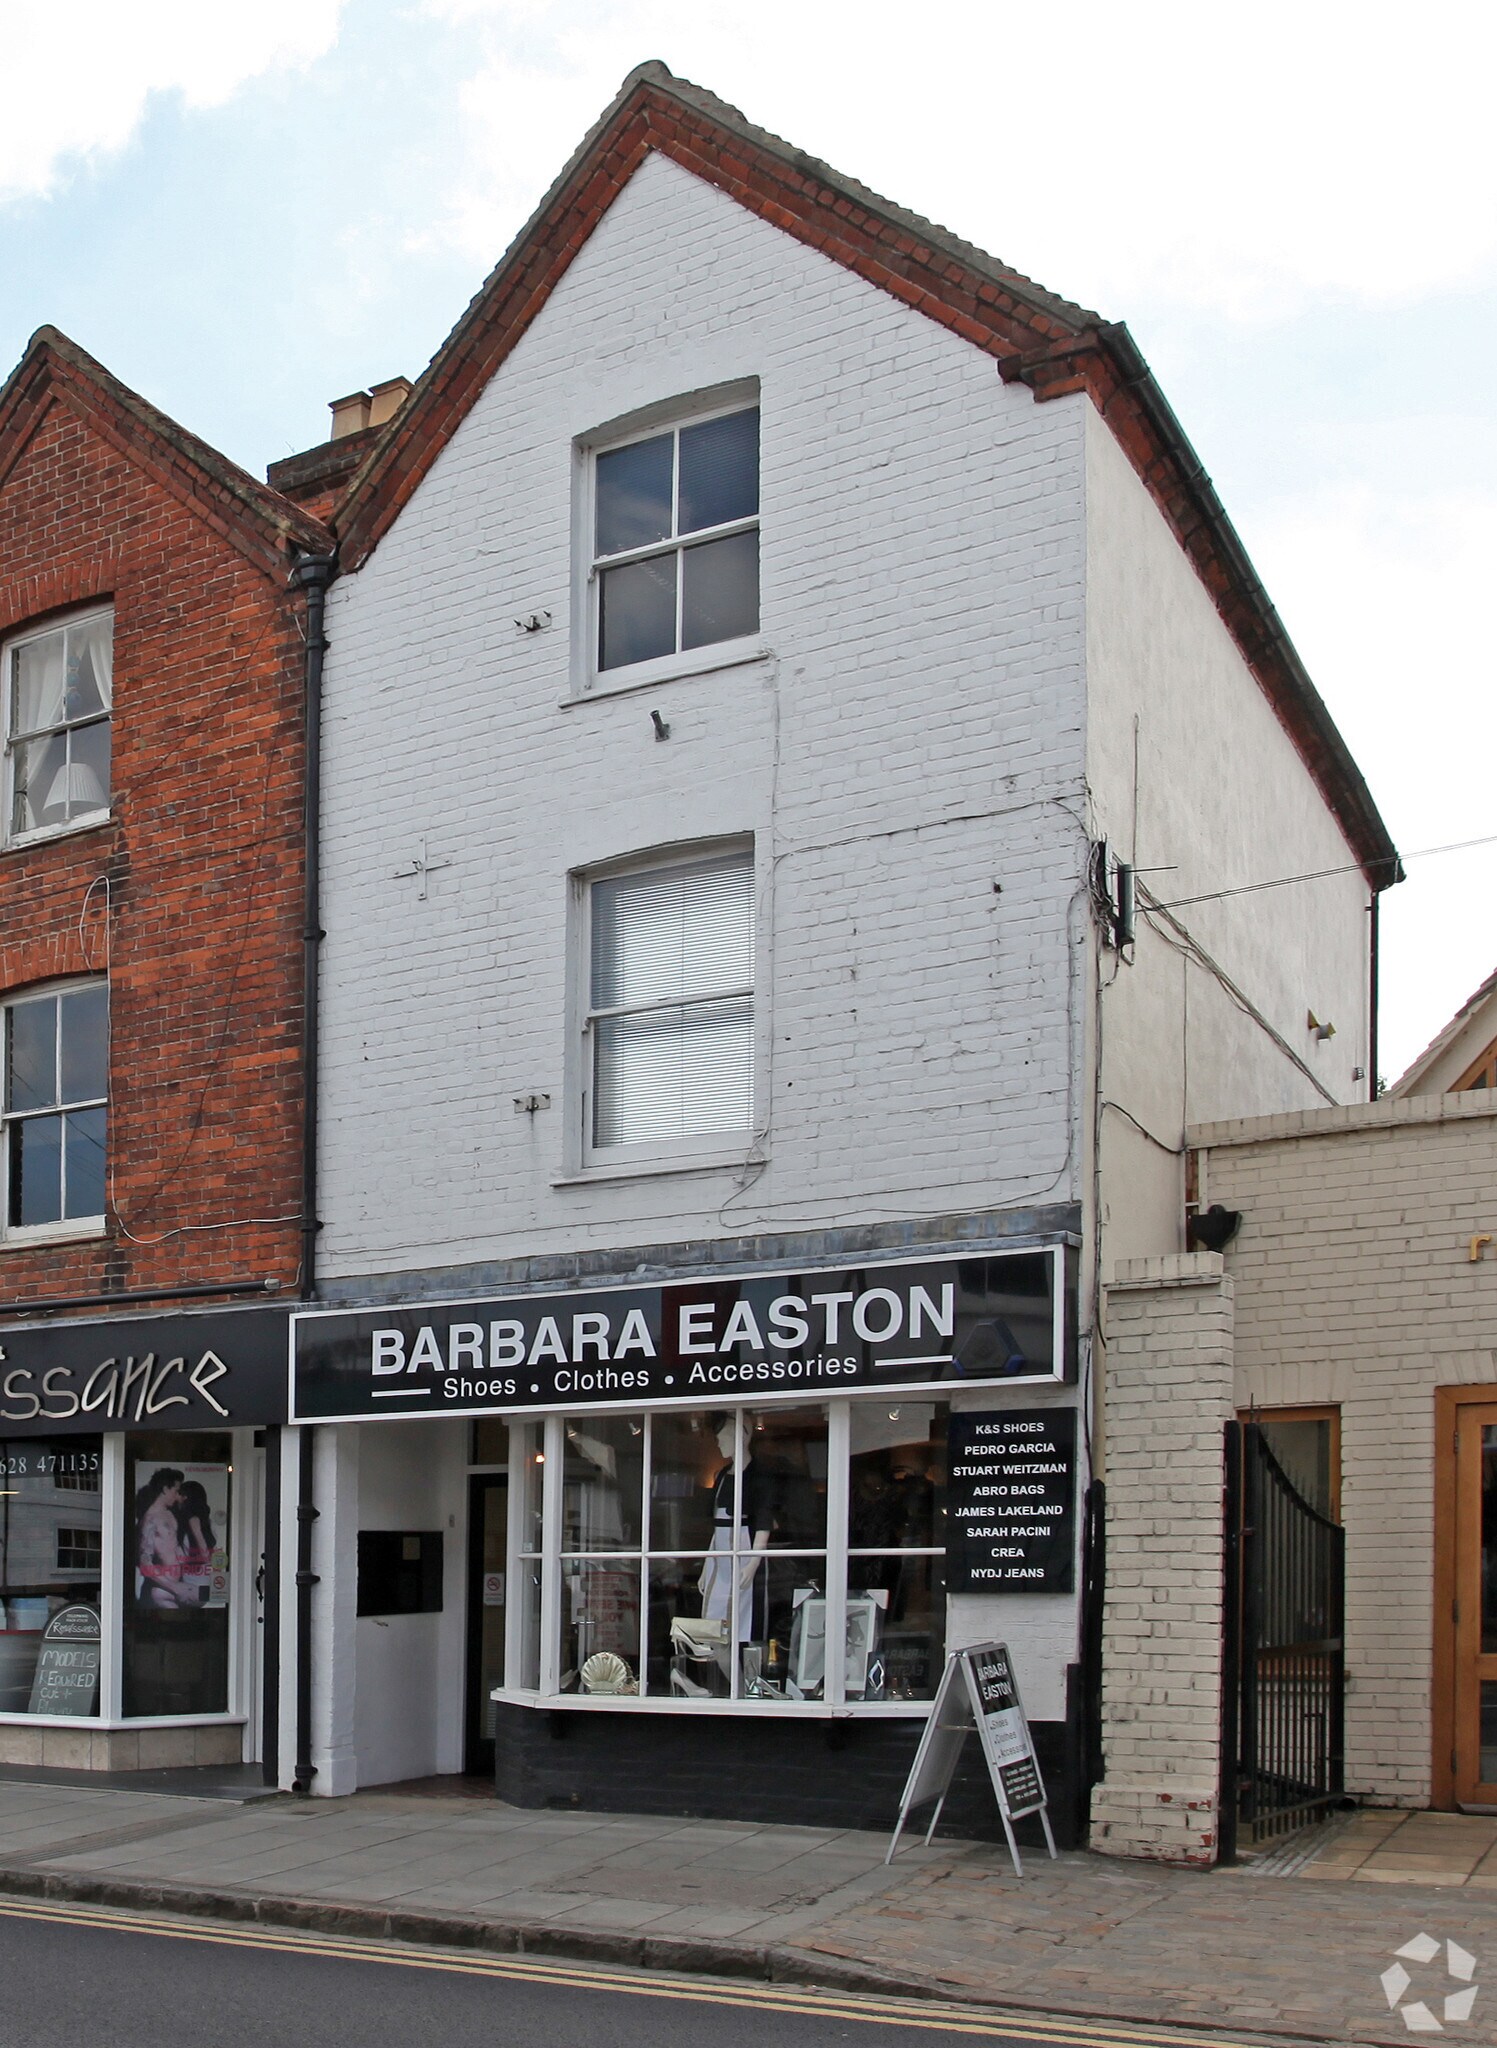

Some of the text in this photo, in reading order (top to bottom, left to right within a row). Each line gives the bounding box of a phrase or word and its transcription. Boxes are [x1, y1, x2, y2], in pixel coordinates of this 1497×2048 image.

[371, 1283, 954, 1376] BARBARA EASTON
[443, 1353, 857, 1399] Shoes Clothes Accessories
[975, 1422, 1045, 1435] K&S SHOES
[964, 1443, 1056, 1456] PEDRO GARCIA
[37, 1453, 99, 1472] 471135
[953, 1463, 1067, 1477] STUART WEITZMAN
[973, 1485, 1045, 1497] ABRO BAGS
[955, 1505, 1063, 1517] JAMES LAKELAND
[966, 1526, 1051, 1538] SARAH PACINI
[991, 1548, 1025, 1558] CREA
[971, 1568, 1045, 1579] NYDJ JEANS
[982, 1681, 1012, 1700] EASTON
